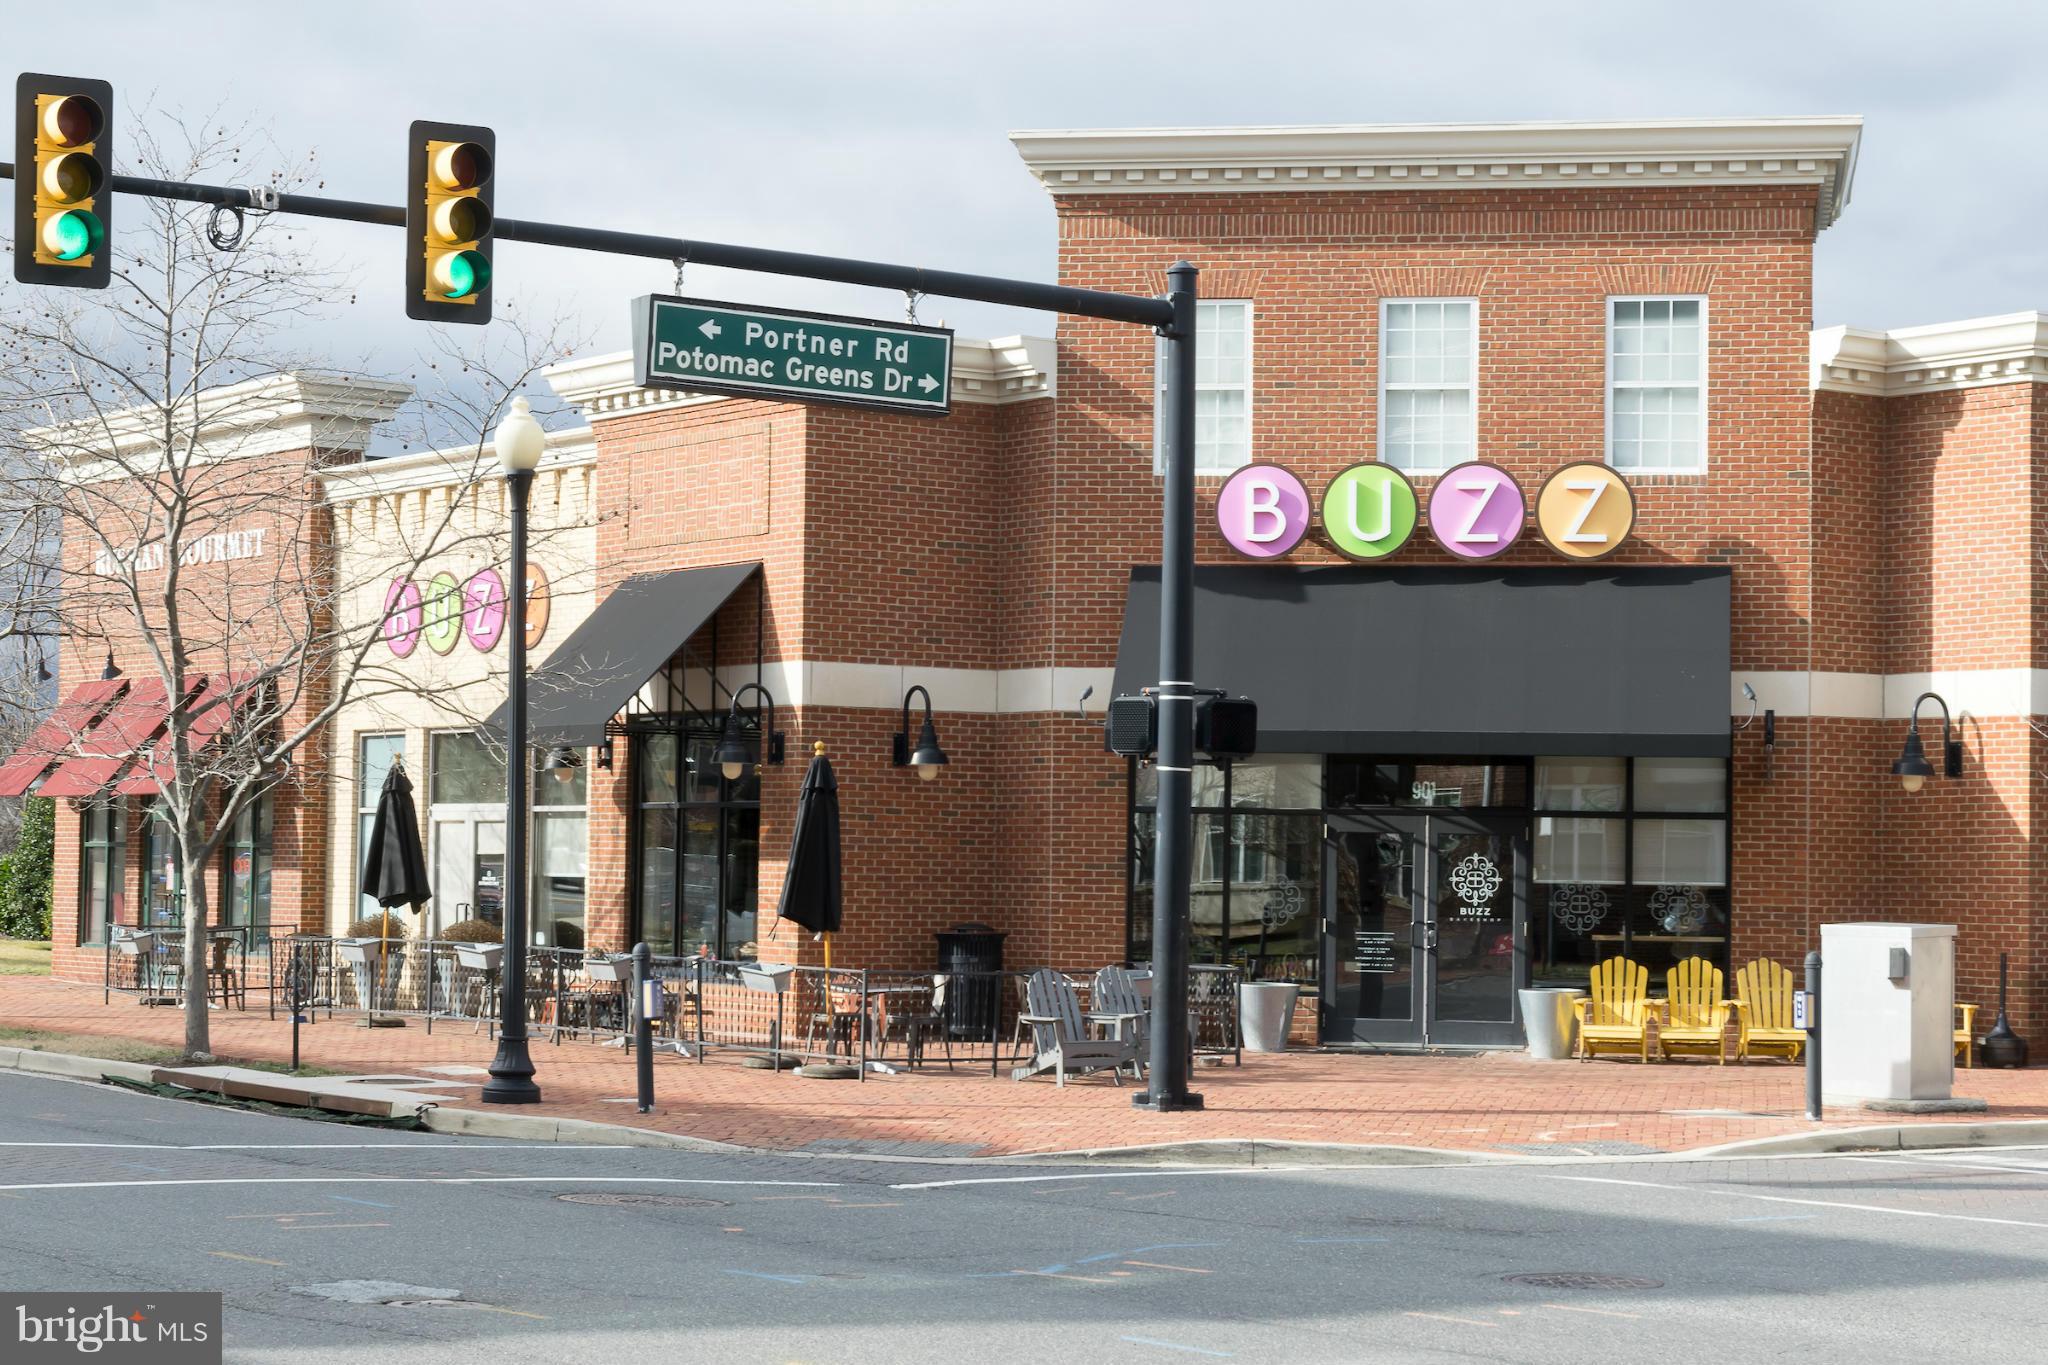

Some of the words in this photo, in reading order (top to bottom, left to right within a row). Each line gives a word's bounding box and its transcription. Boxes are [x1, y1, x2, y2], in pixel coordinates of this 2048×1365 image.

[745, 321, 858, 358] Portner
[876, 337, 909, 364] Rd
[658, 342, 774, 379] Potomac
[786, 357, 873, 390] Greens
[884, 368, 913, 393] Dr
[1244, 479, 1610, 543] BUZZ
[1412, 781, 1436, 800] 901
[1459, 907, 1491, 916] BUZZ
